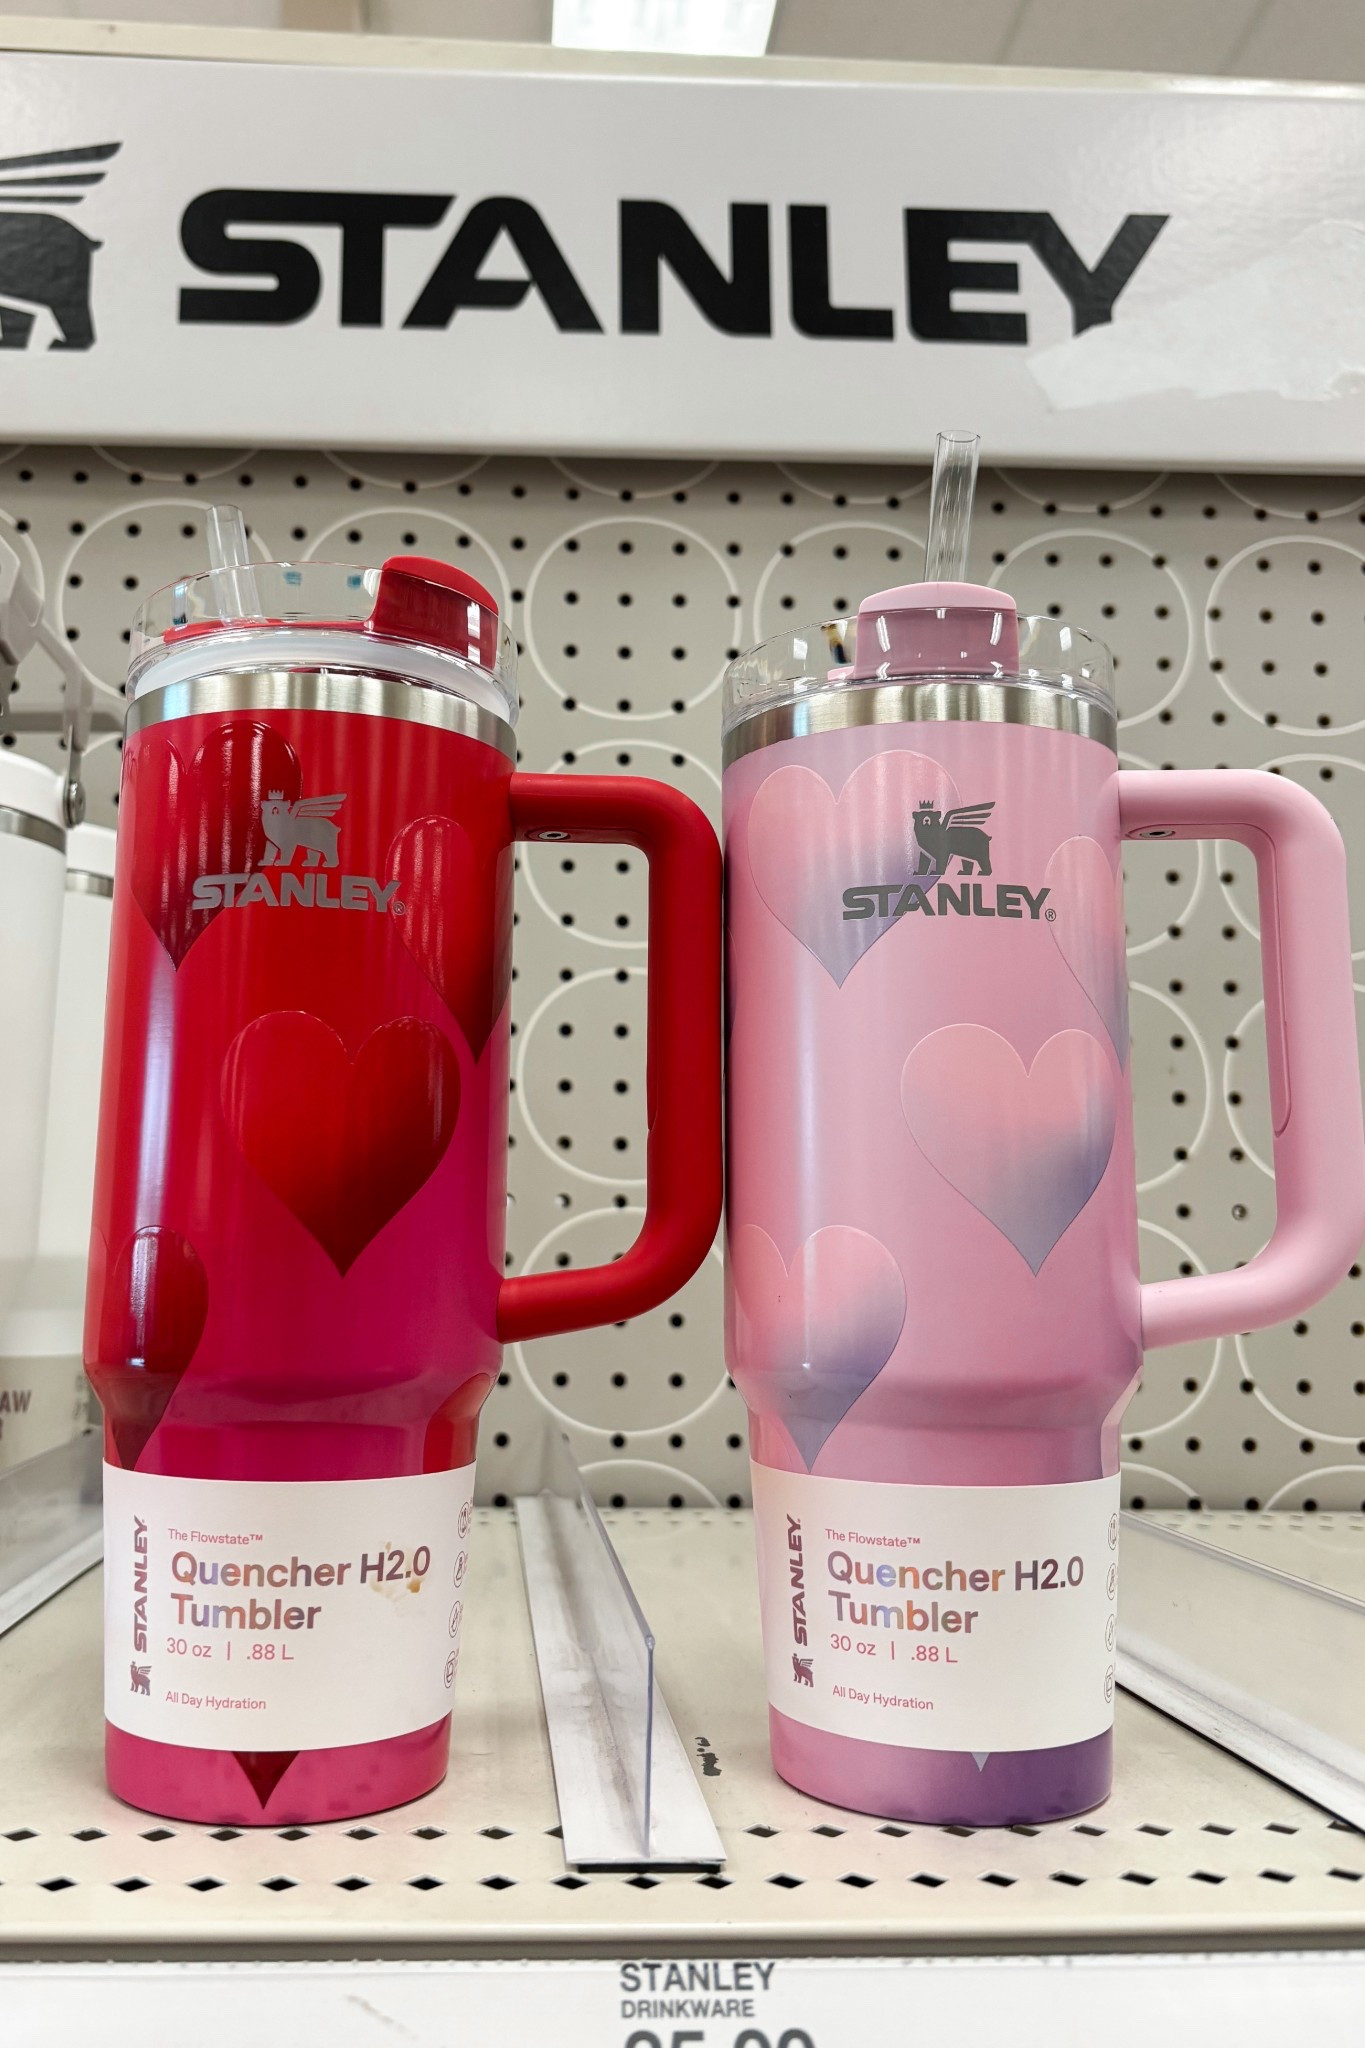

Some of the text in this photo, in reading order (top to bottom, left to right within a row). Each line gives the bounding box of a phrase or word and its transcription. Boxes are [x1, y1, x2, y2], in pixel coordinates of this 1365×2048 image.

[178, 188, 1170, 344] STANLEY
[168, 1528, 188, 1541] The
[825, 1528, 846, 1542] The
[171, 1551, 352, 1588] Quencher
[359, 1545, 431, 1584] H2.0
[827, 1550, 1085, 1592] Quencher H2.0
[170, 1592, 323, 1630] Tumbler
[828, 1590, 979, 1634] Tumbler
[166, 1637, 188, 1655] 30
[192, 1644, 212, 1658] oz
[246, 1643, 276, 1660] .88
[281, 1645, 294, 1660] L
[830, 1634, 852, 1652] 30
[856, 1641, 876, 1656] oz
[910, 1645, 940, 1662] .88
[945, 1647, 958, 1663] L
[165, 1690, 267, 1711] All Day Hydration
[832, 1685, 934, 1711] All Day Hydration
[620, 1961, 775, 1992] STANLEY
[621, 1999, 756, 2018] DRINKWARE
